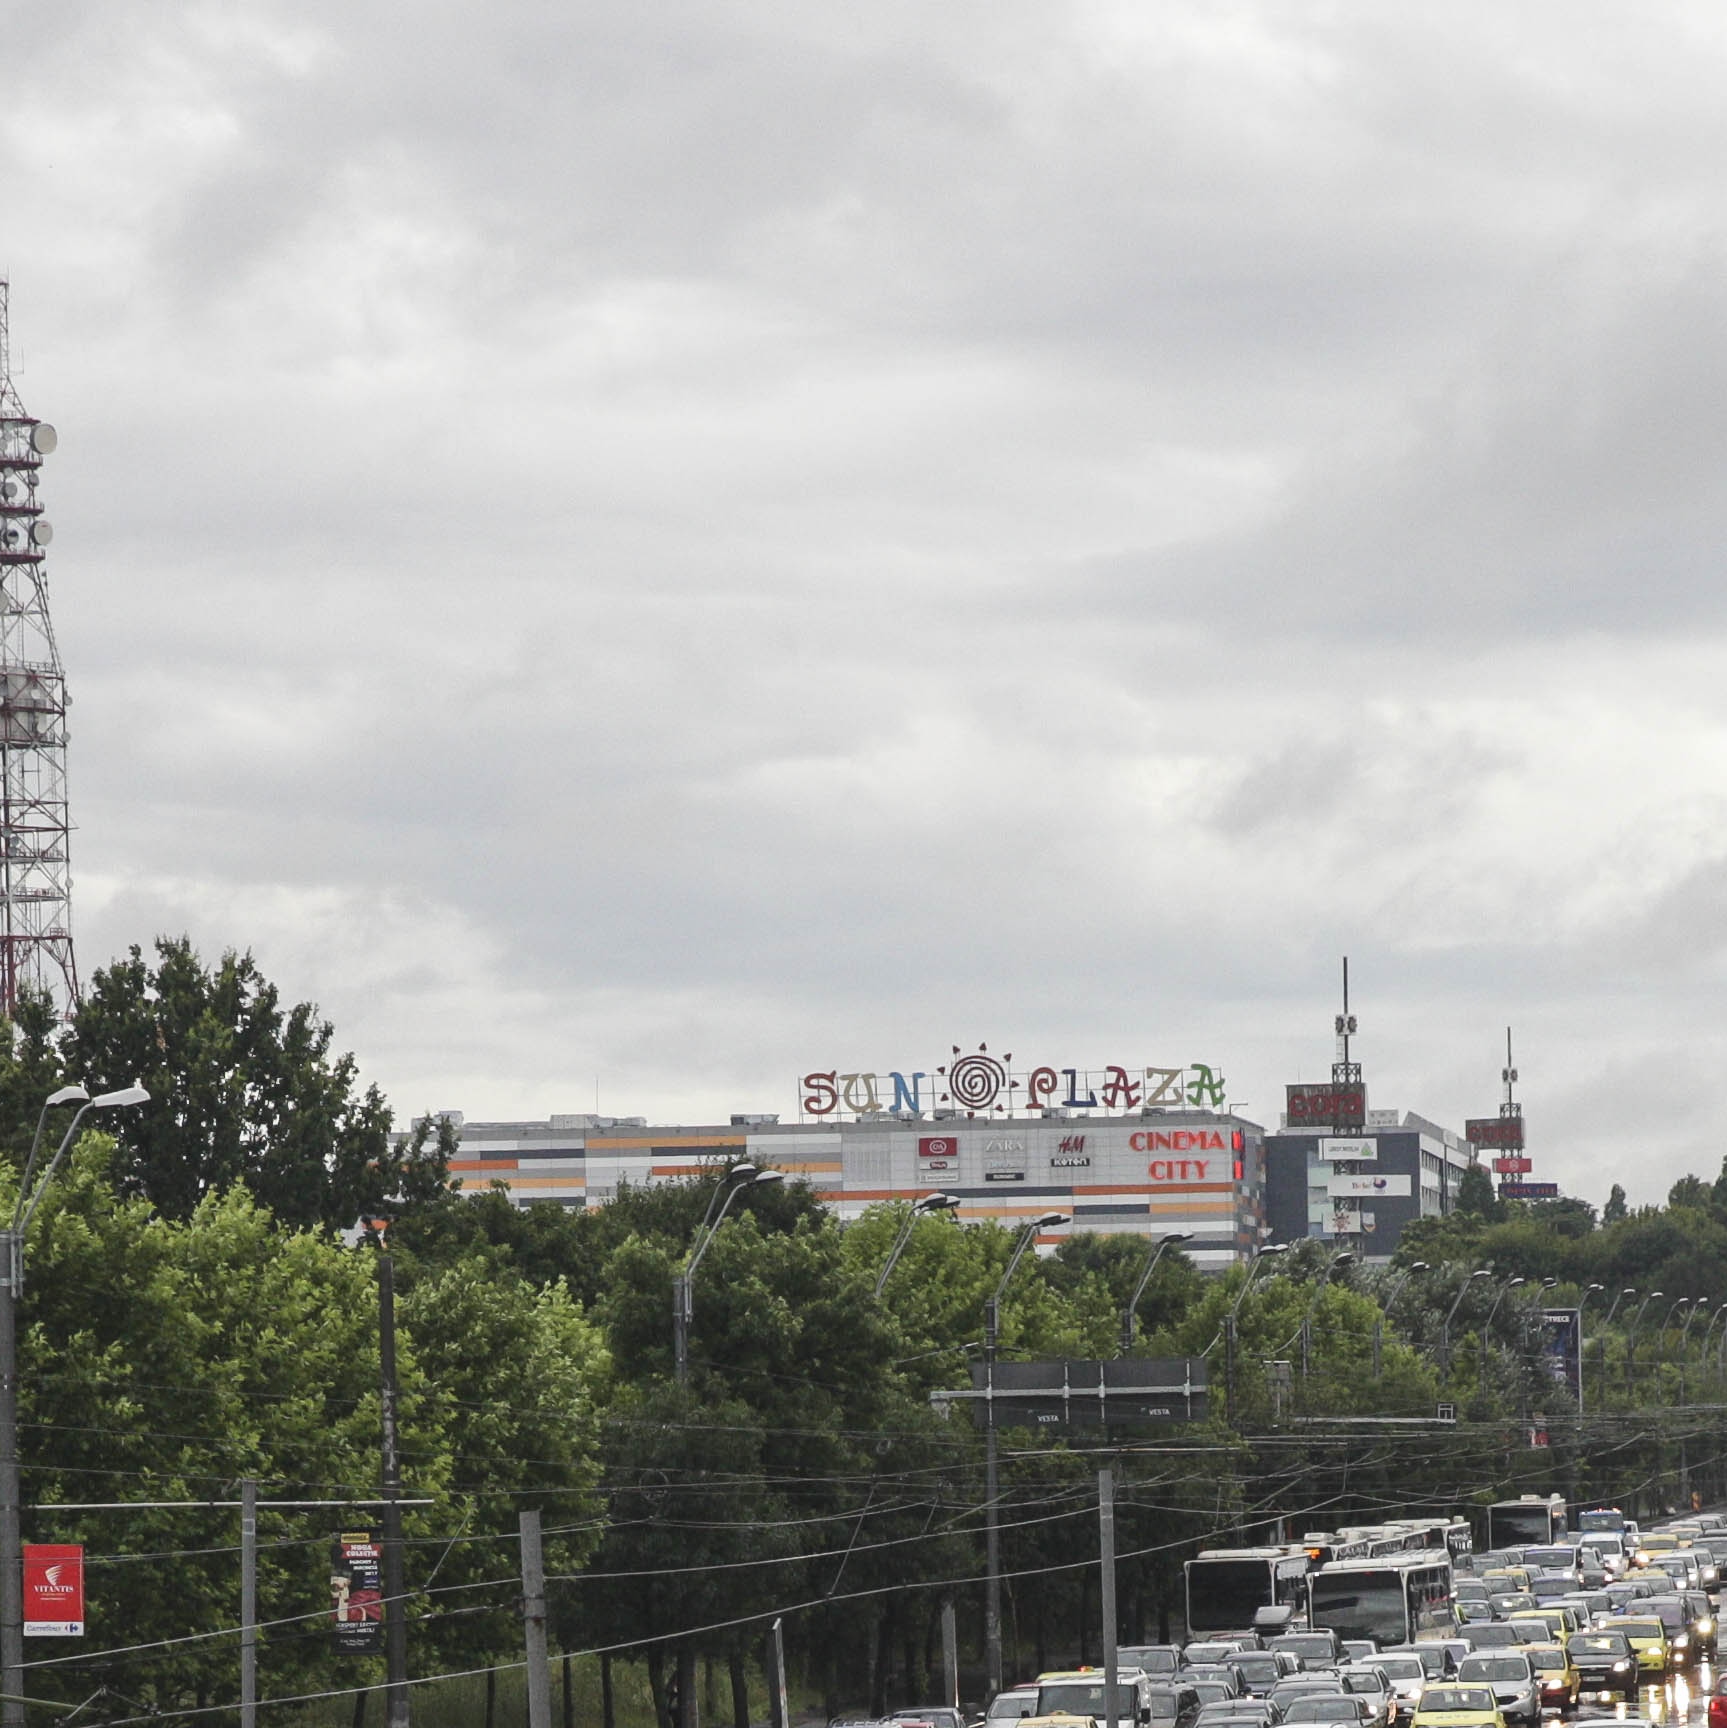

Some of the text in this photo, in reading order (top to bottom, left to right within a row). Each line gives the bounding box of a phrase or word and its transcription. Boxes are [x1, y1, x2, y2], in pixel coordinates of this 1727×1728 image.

[804, 1064, 1225, 1114] SUN PLAZA
[1290, 1093, 1362, 1115] cora
[1058, 1136, 1085, 1152] H&M
[1129, 1131, 1226, 1150] CINEMA
[1148, 1160, 1210, 1180] CITY
